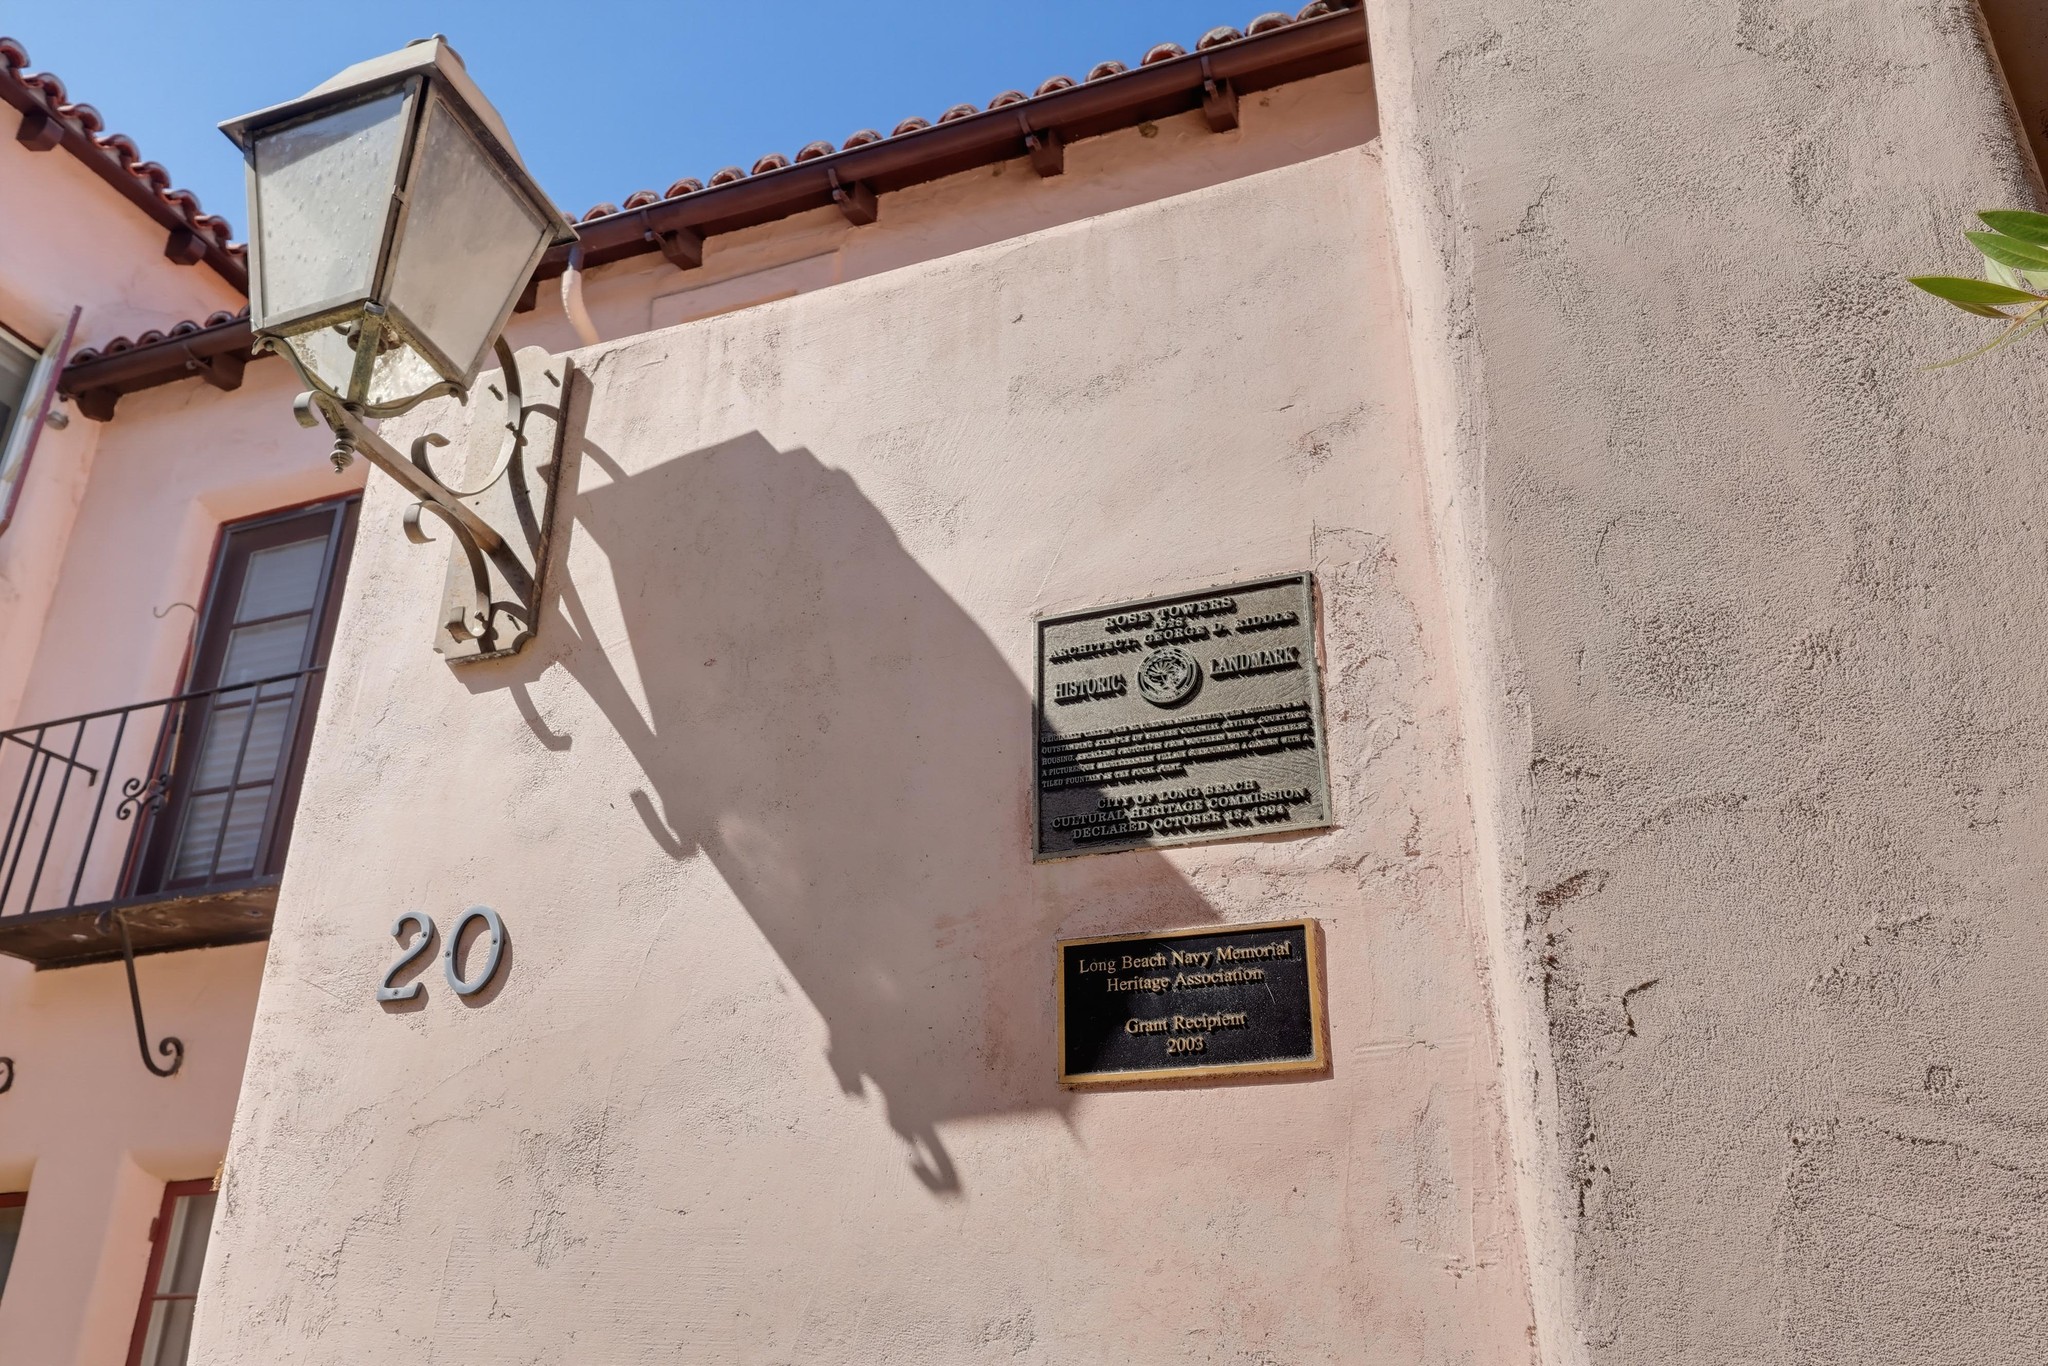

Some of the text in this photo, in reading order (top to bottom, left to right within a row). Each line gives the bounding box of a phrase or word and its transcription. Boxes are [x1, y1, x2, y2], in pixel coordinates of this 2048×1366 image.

[1105, 597, 1234, 628] ROSE TOWERS
[1144, 625, 1207, 643] GEORGE
[1236, 610, 1297, 627] RIDDLE
[1054, 674, 1122, 698] HISTORIC
[1211, 646, 1297, 674] LANDMARK
[1041, 740, 1093, 754] OUTSTANDING
[1041, 778, 1063, 788] TILED
[1065, 773, 1101, 785] FOUNTAIN
[1097, 780, 1256, 809] CITY OF LONG BEACH
[1052, 788, 1306, 828] CULTURAL HERITAGE COMMISSION
[1072, 820, 1149, 839] DECLARED
[1153, 811, 1222, 830] OCTOBER
[376, 904, 505, 1002] 20
[1079, 940, 1291, 974] Long Beach Navy Memorial
[1106, 966, 1264, 994] Heritage Association
[1125, 1012, 1246, 1034] Grant Recipient
[1166, 1037, 1205, 1054] 2003
